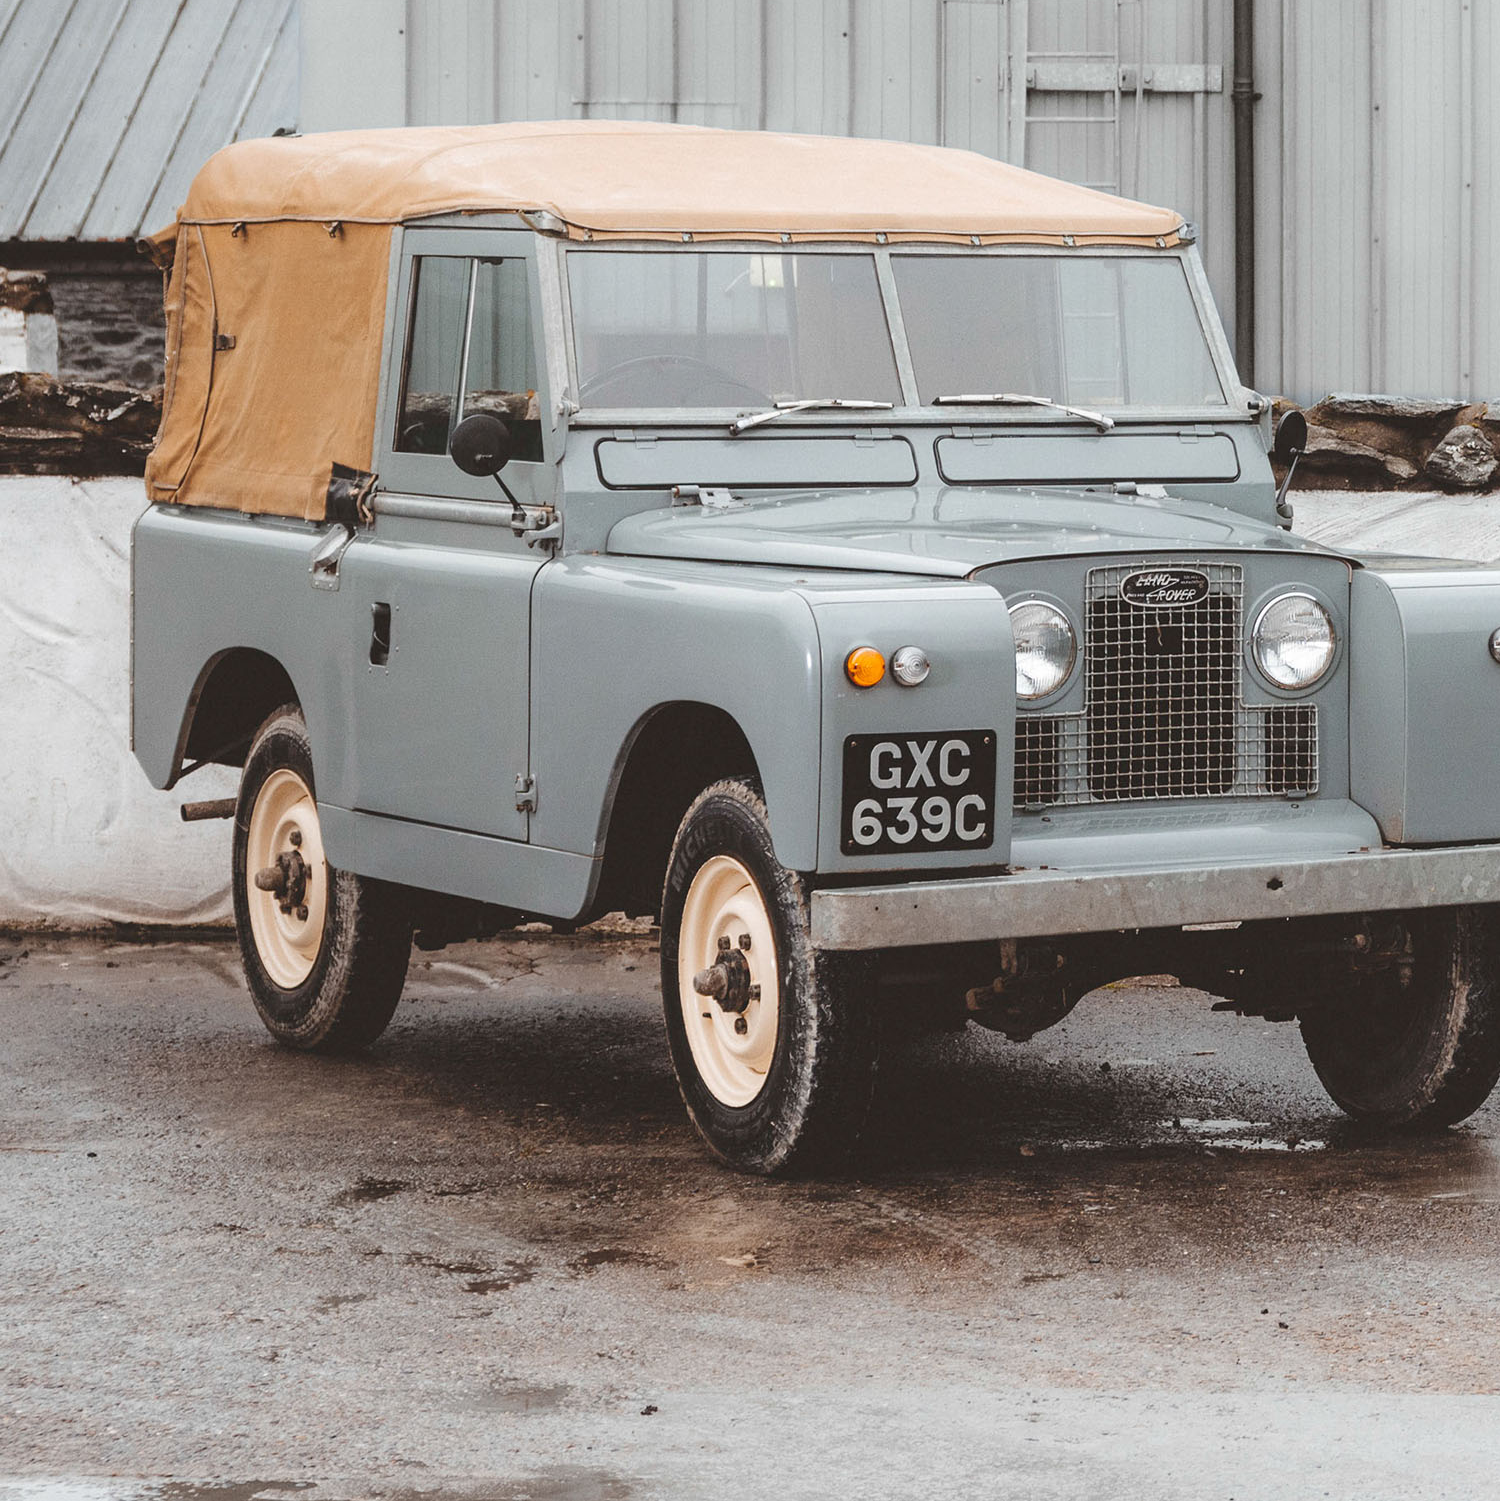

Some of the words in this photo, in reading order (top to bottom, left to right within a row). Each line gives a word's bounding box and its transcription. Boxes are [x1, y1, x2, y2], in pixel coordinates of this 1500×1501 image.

[1135, 573, 1171, 587] LAND
[1155, 588, 1196, 602] ROVER
[869, 739, 971, 789] GXC
[851, 794, 986, 846] 639C
